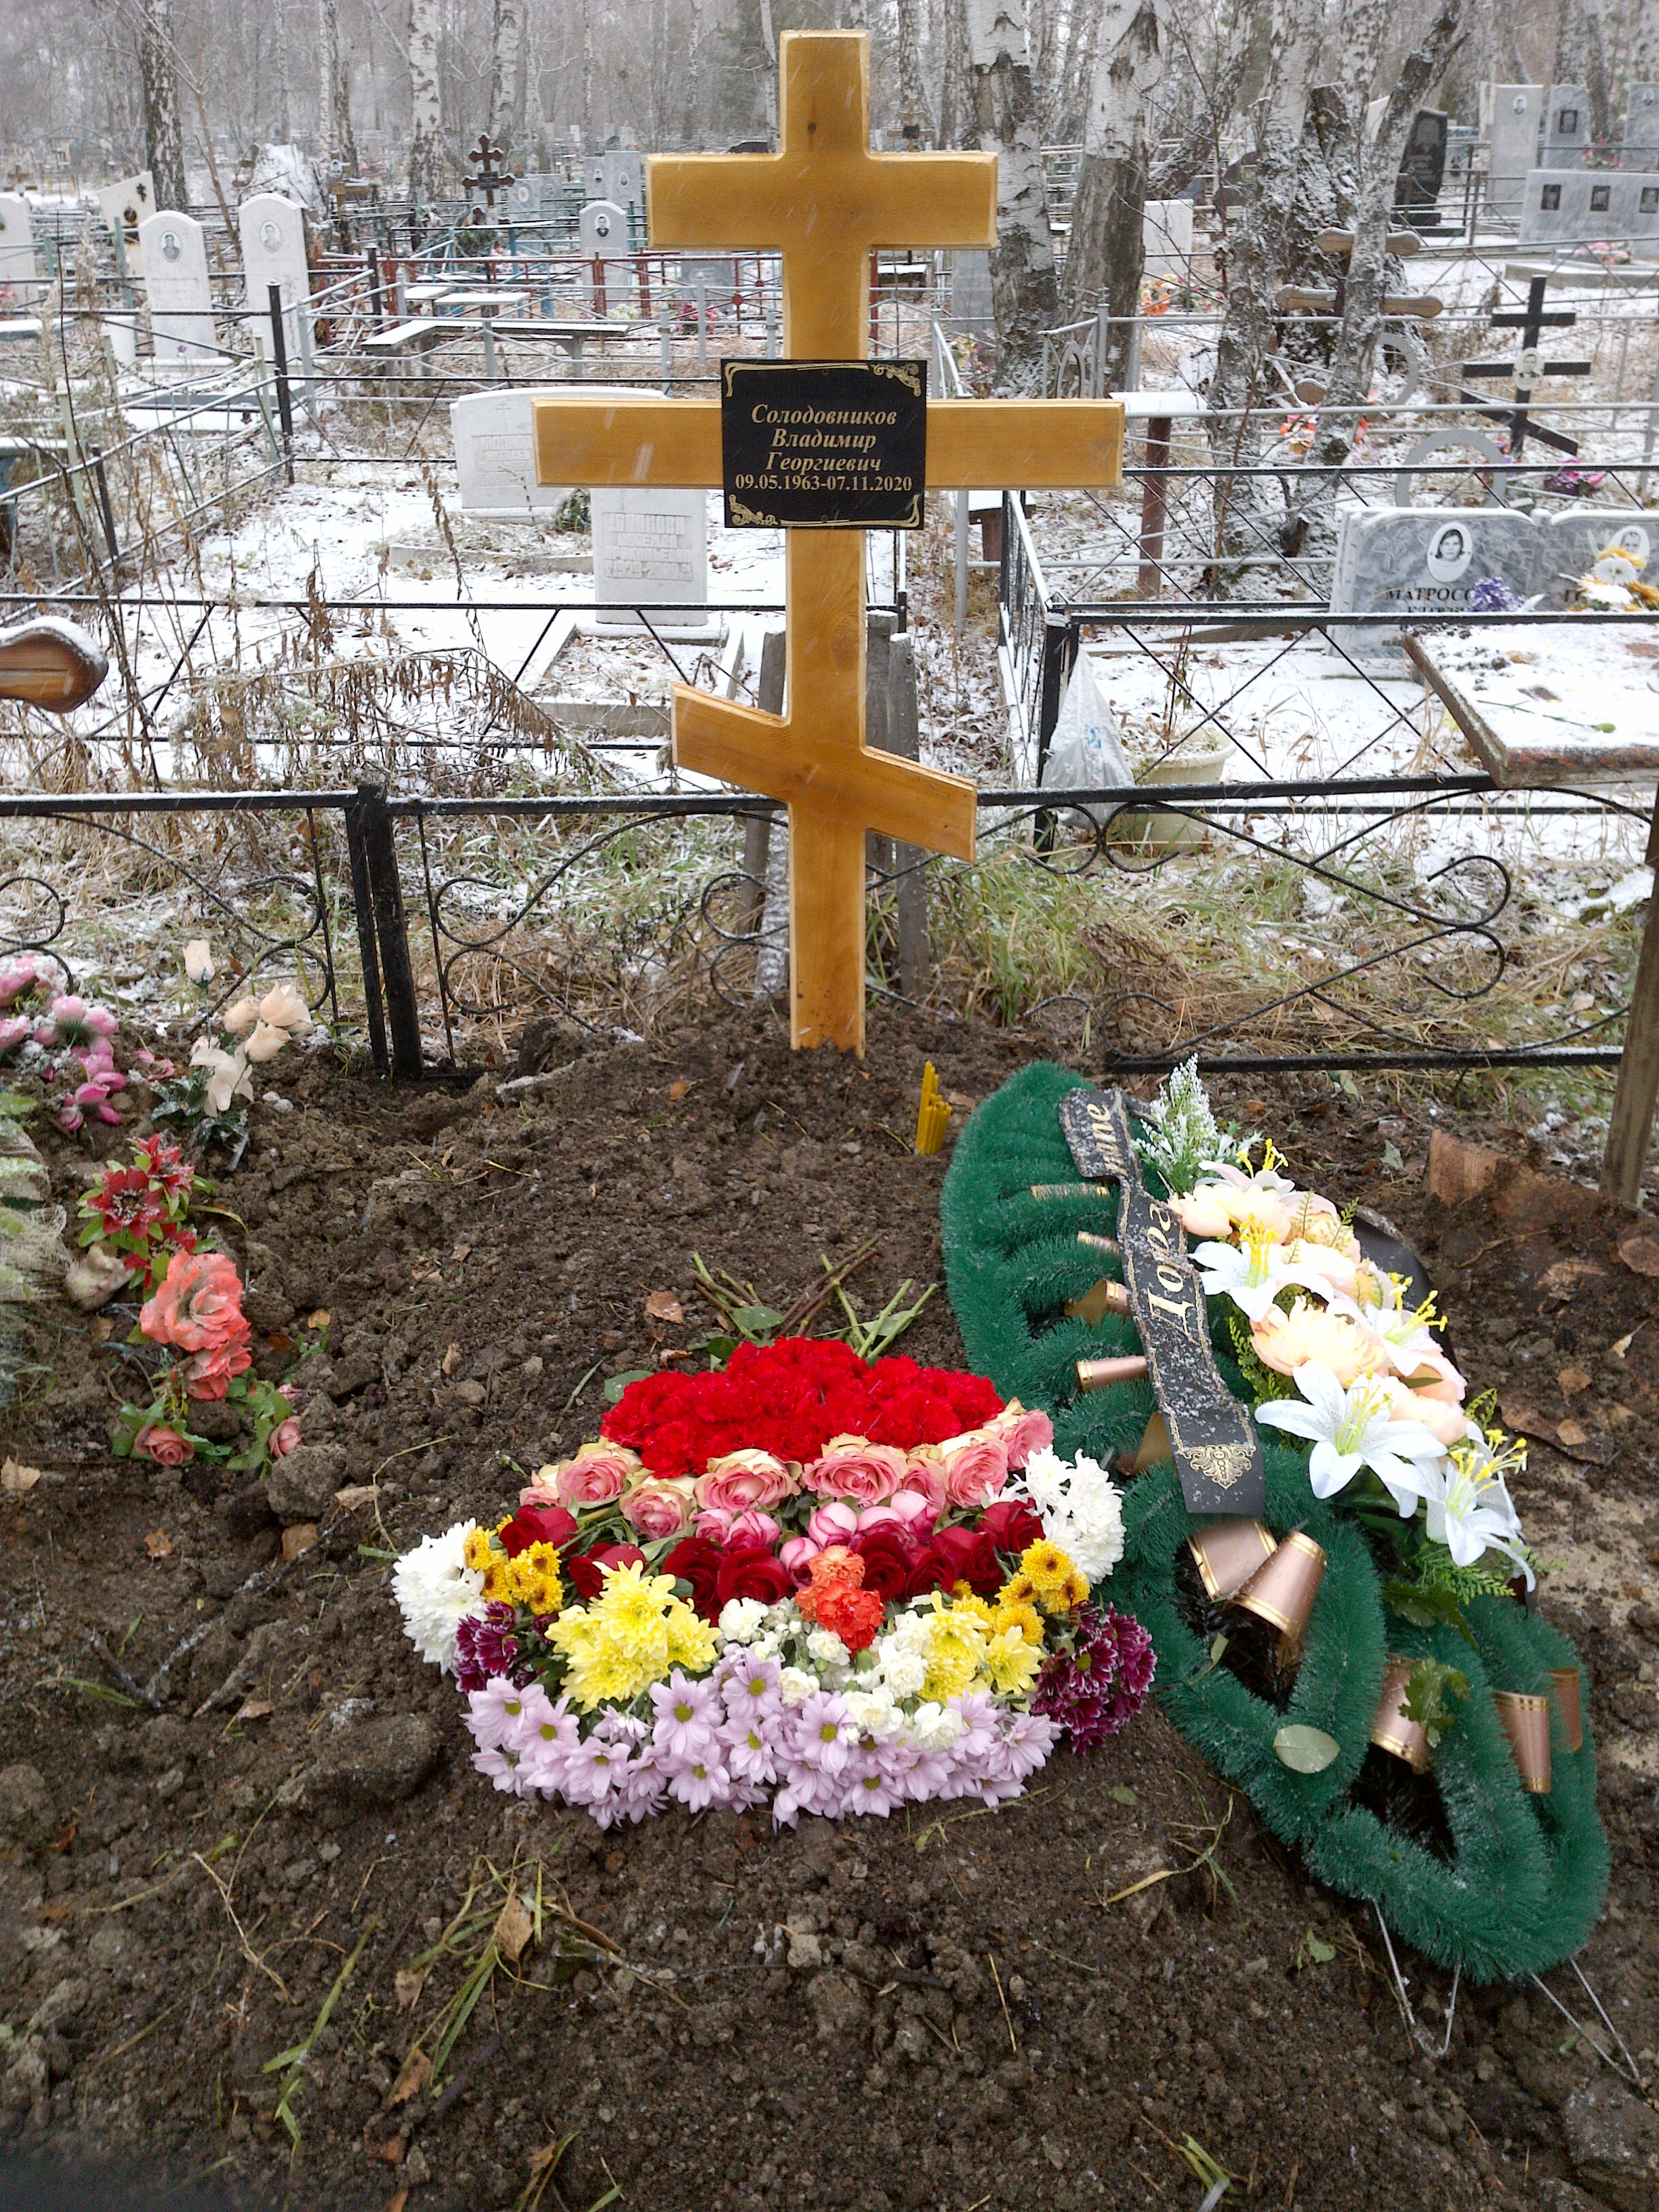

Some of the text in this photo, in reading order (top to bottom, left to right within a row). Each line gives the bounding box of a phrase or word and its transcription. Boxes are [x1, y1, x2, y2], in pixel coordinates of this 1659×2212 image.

[751, 403, 897, 425] Солодовников
[771, 428, 877, 453] Владимир
[765, 451, 882, 475] Георгиевич
[735, 474, 912, 491] 09.05.1963-07.11.2020
